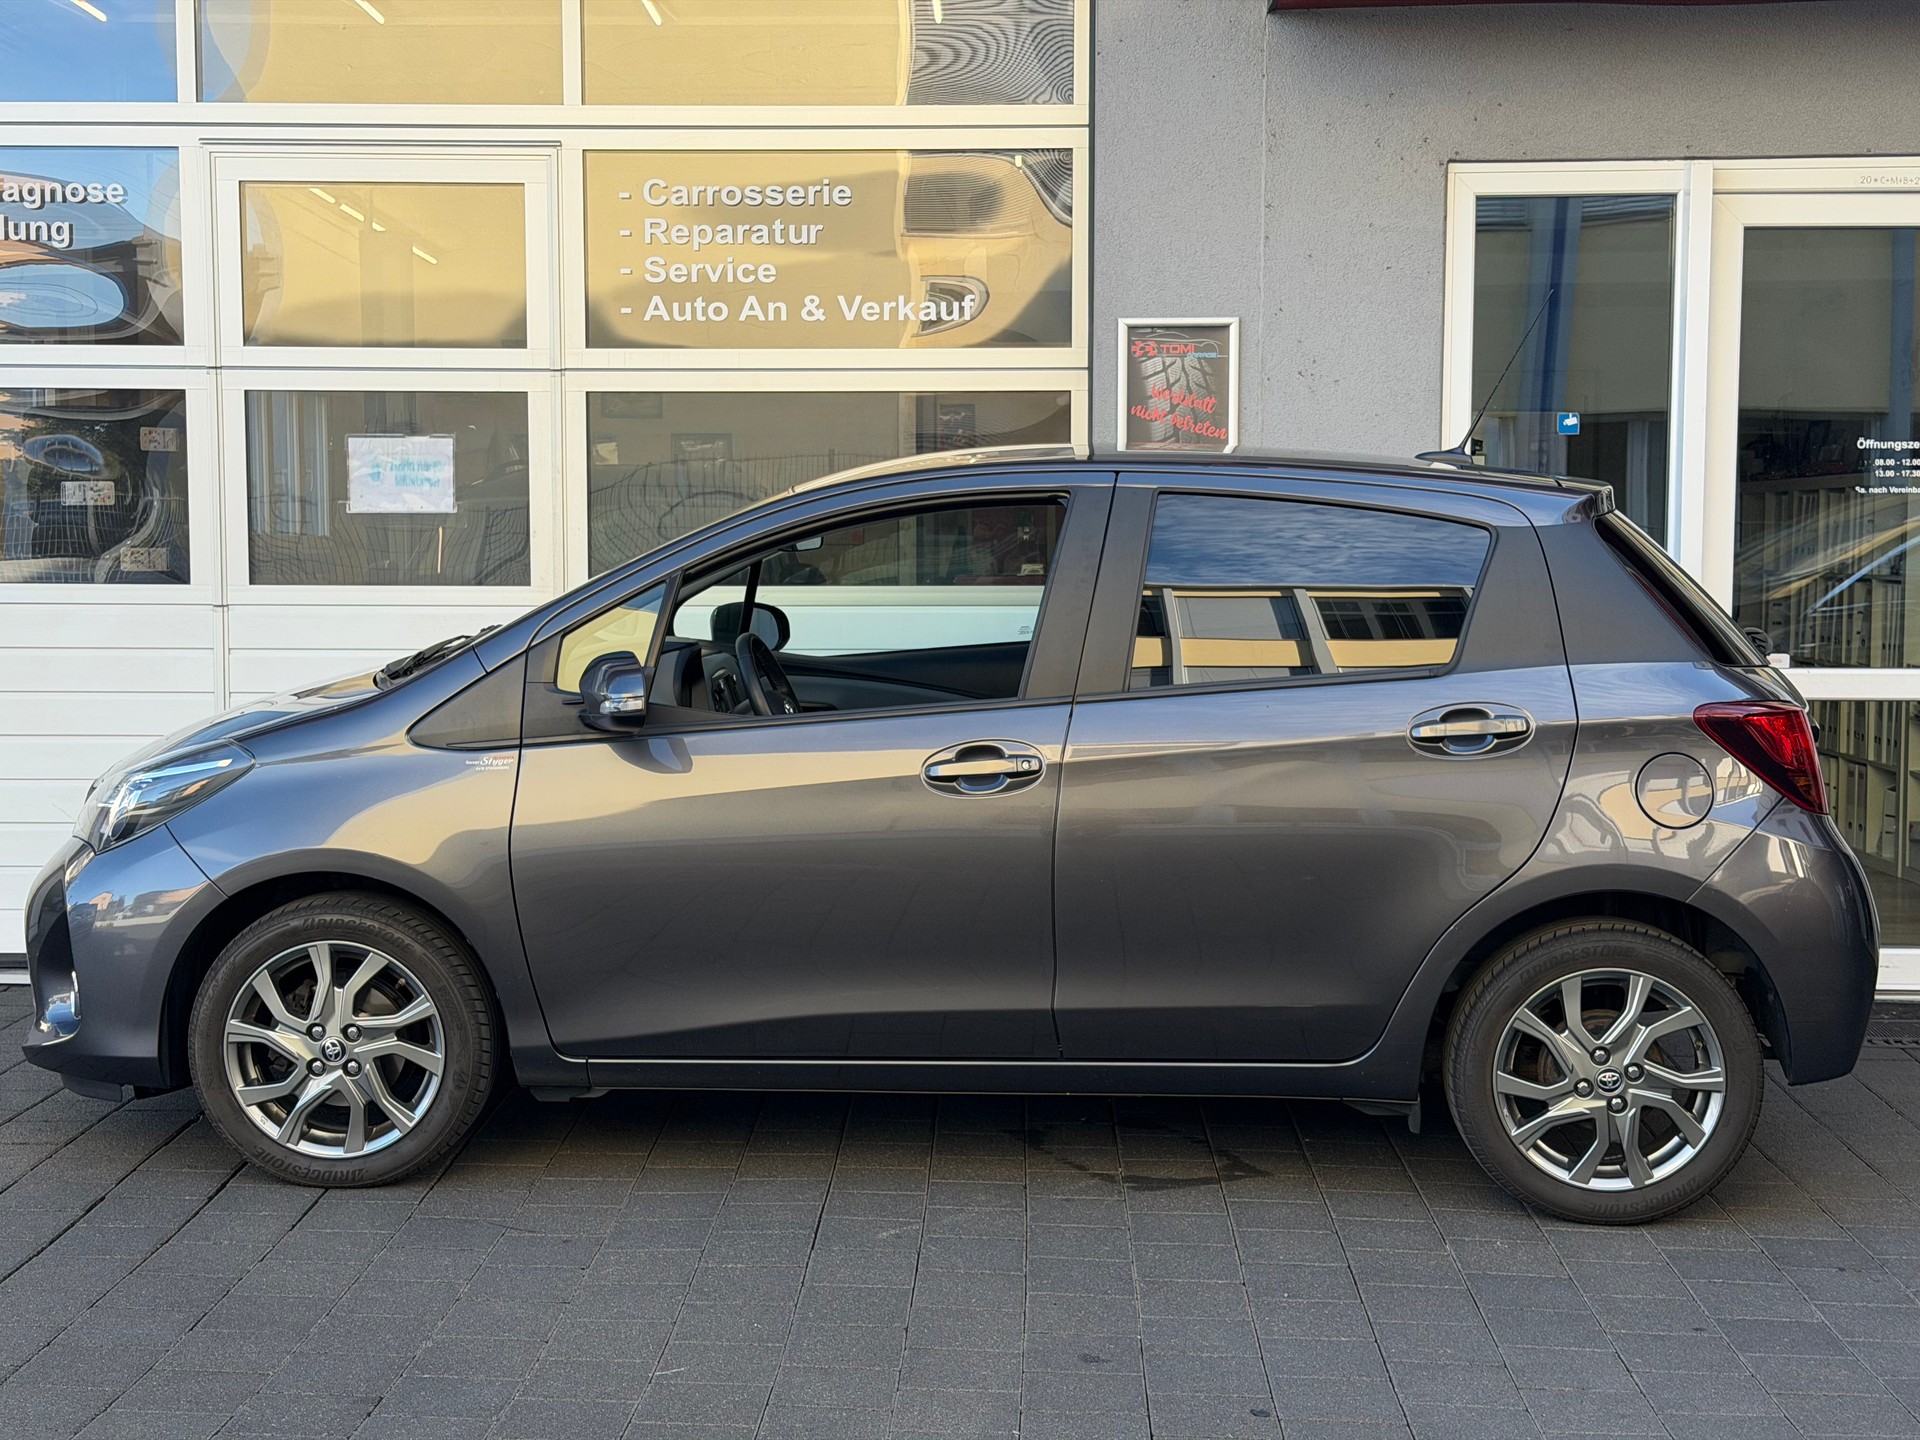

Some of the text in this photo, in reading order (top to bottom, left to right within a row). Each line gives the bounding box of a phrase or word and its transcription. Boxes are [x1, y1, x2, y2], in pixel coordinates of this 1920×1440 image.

[2, 182, 125, 209] agnose
[642, 178, 853, 207] Carrosserie
[643, 218, 824, 251] Reparatur
[643, 257, 778, 284] Service
[643, 295, 729, 322] Auto
[738, 295, 788, 322] An
[800, 295, 827, 322] &
[837, 295, 975, 322] Verkauf
[1160, 343, 1195, 354] TOMI
[1170, 412, 1227, 440] betreten
[1857, 437, 1920, 451] Öffnungsze
[480, 757, 513, 766] Styger
[302, 916, 416, 954] BRIDGESTONE
[252, 1146, 367, 1183] BRIDGESTONE
